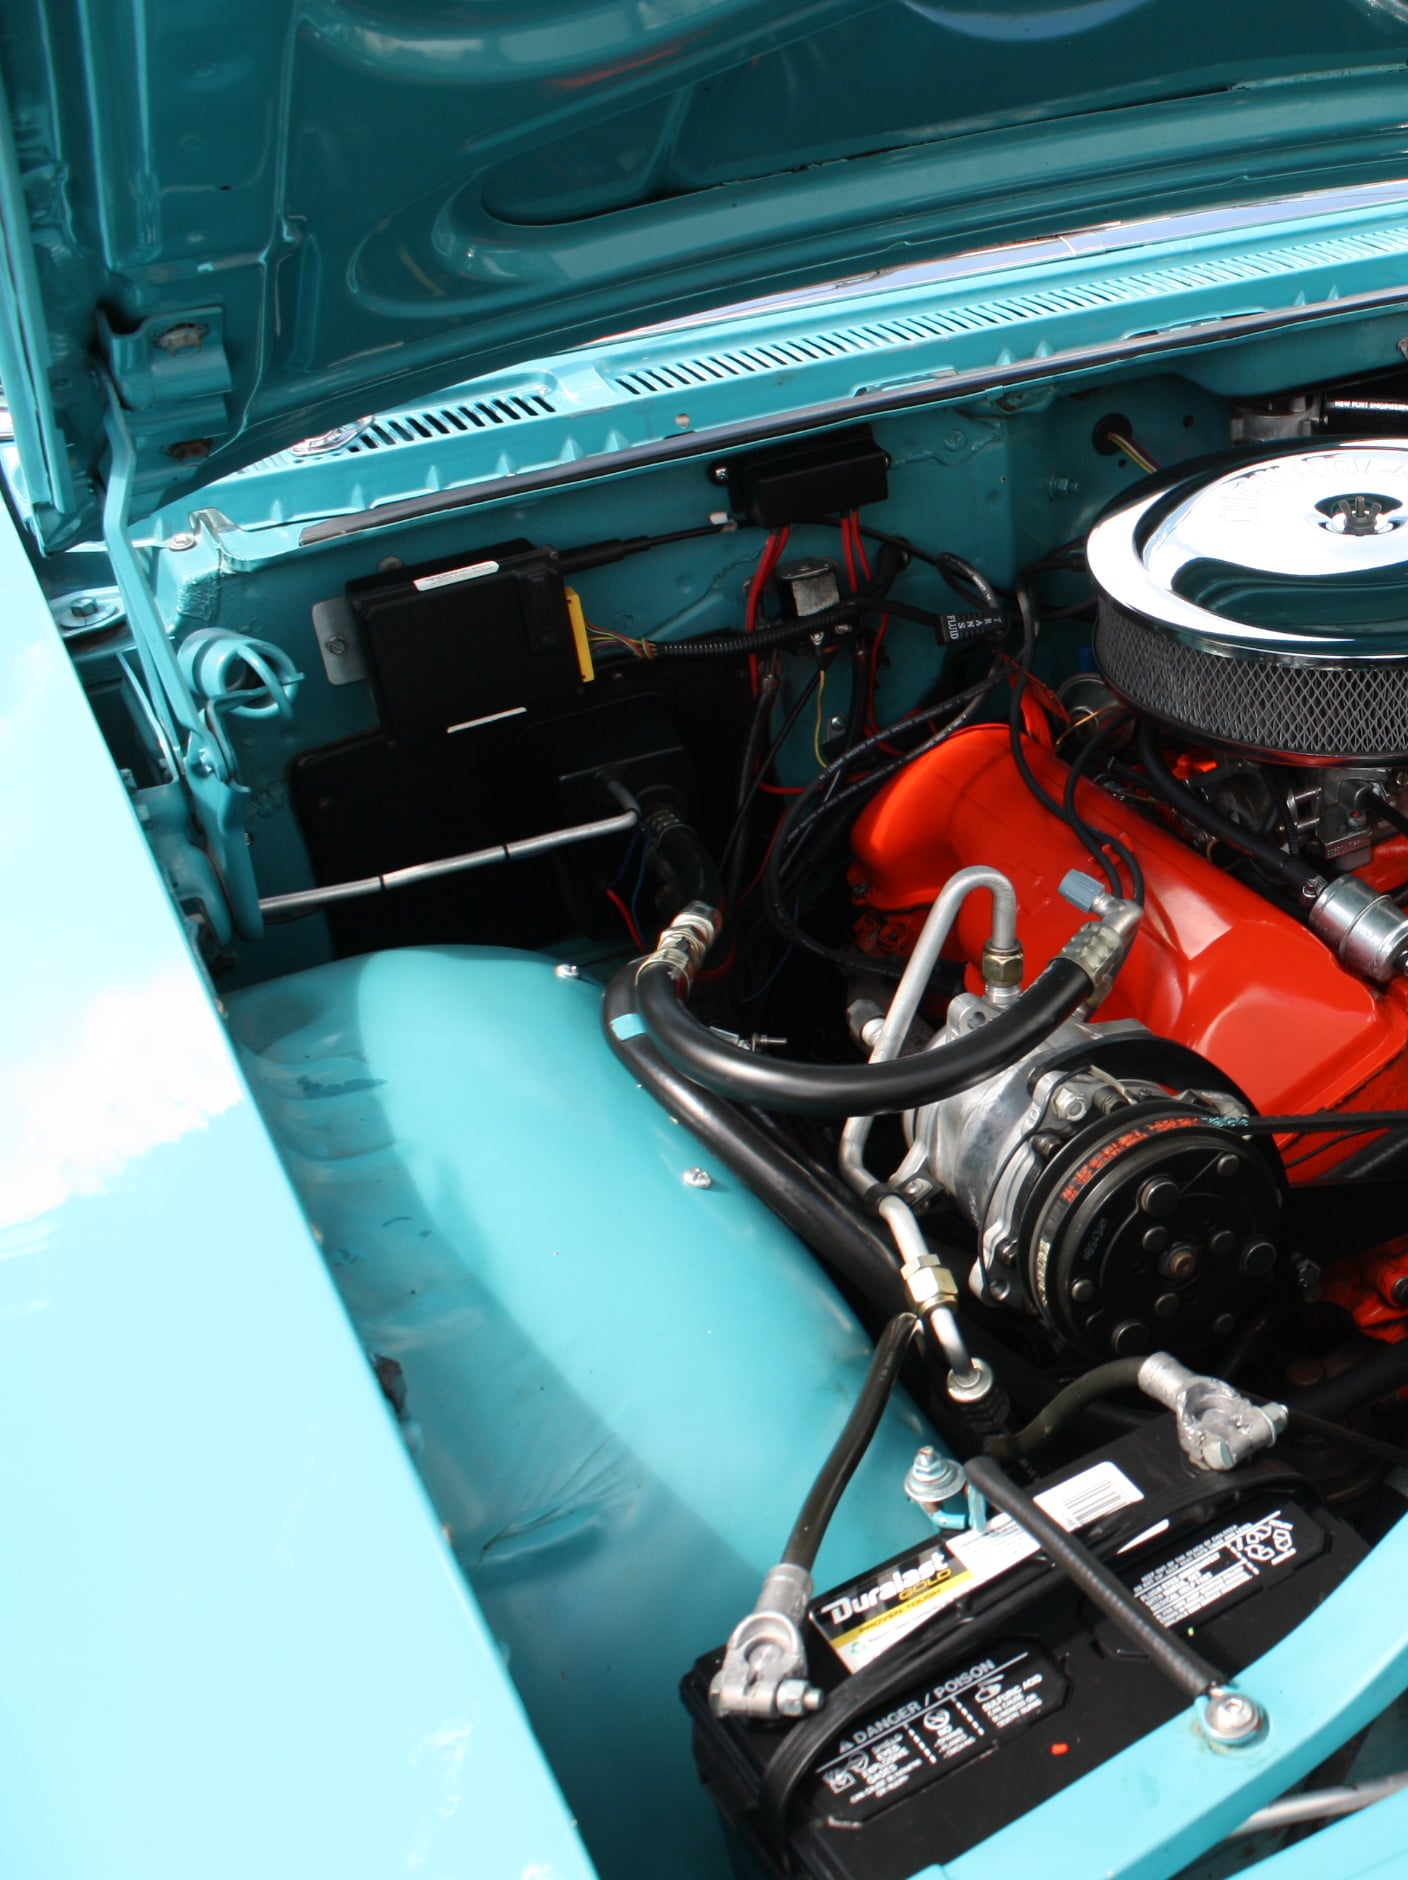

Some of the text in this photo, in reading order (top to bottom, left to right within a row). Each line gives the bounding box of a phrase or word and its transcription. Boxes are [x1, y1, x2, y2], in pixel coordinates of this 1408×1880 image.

[820, 1551, 948, 1624] Duralast
[898, 1569, 951, 1600] GOLD
[853, 1701, 922, 1745] DANGER
[934, 1659, 996, 1699] POISON
